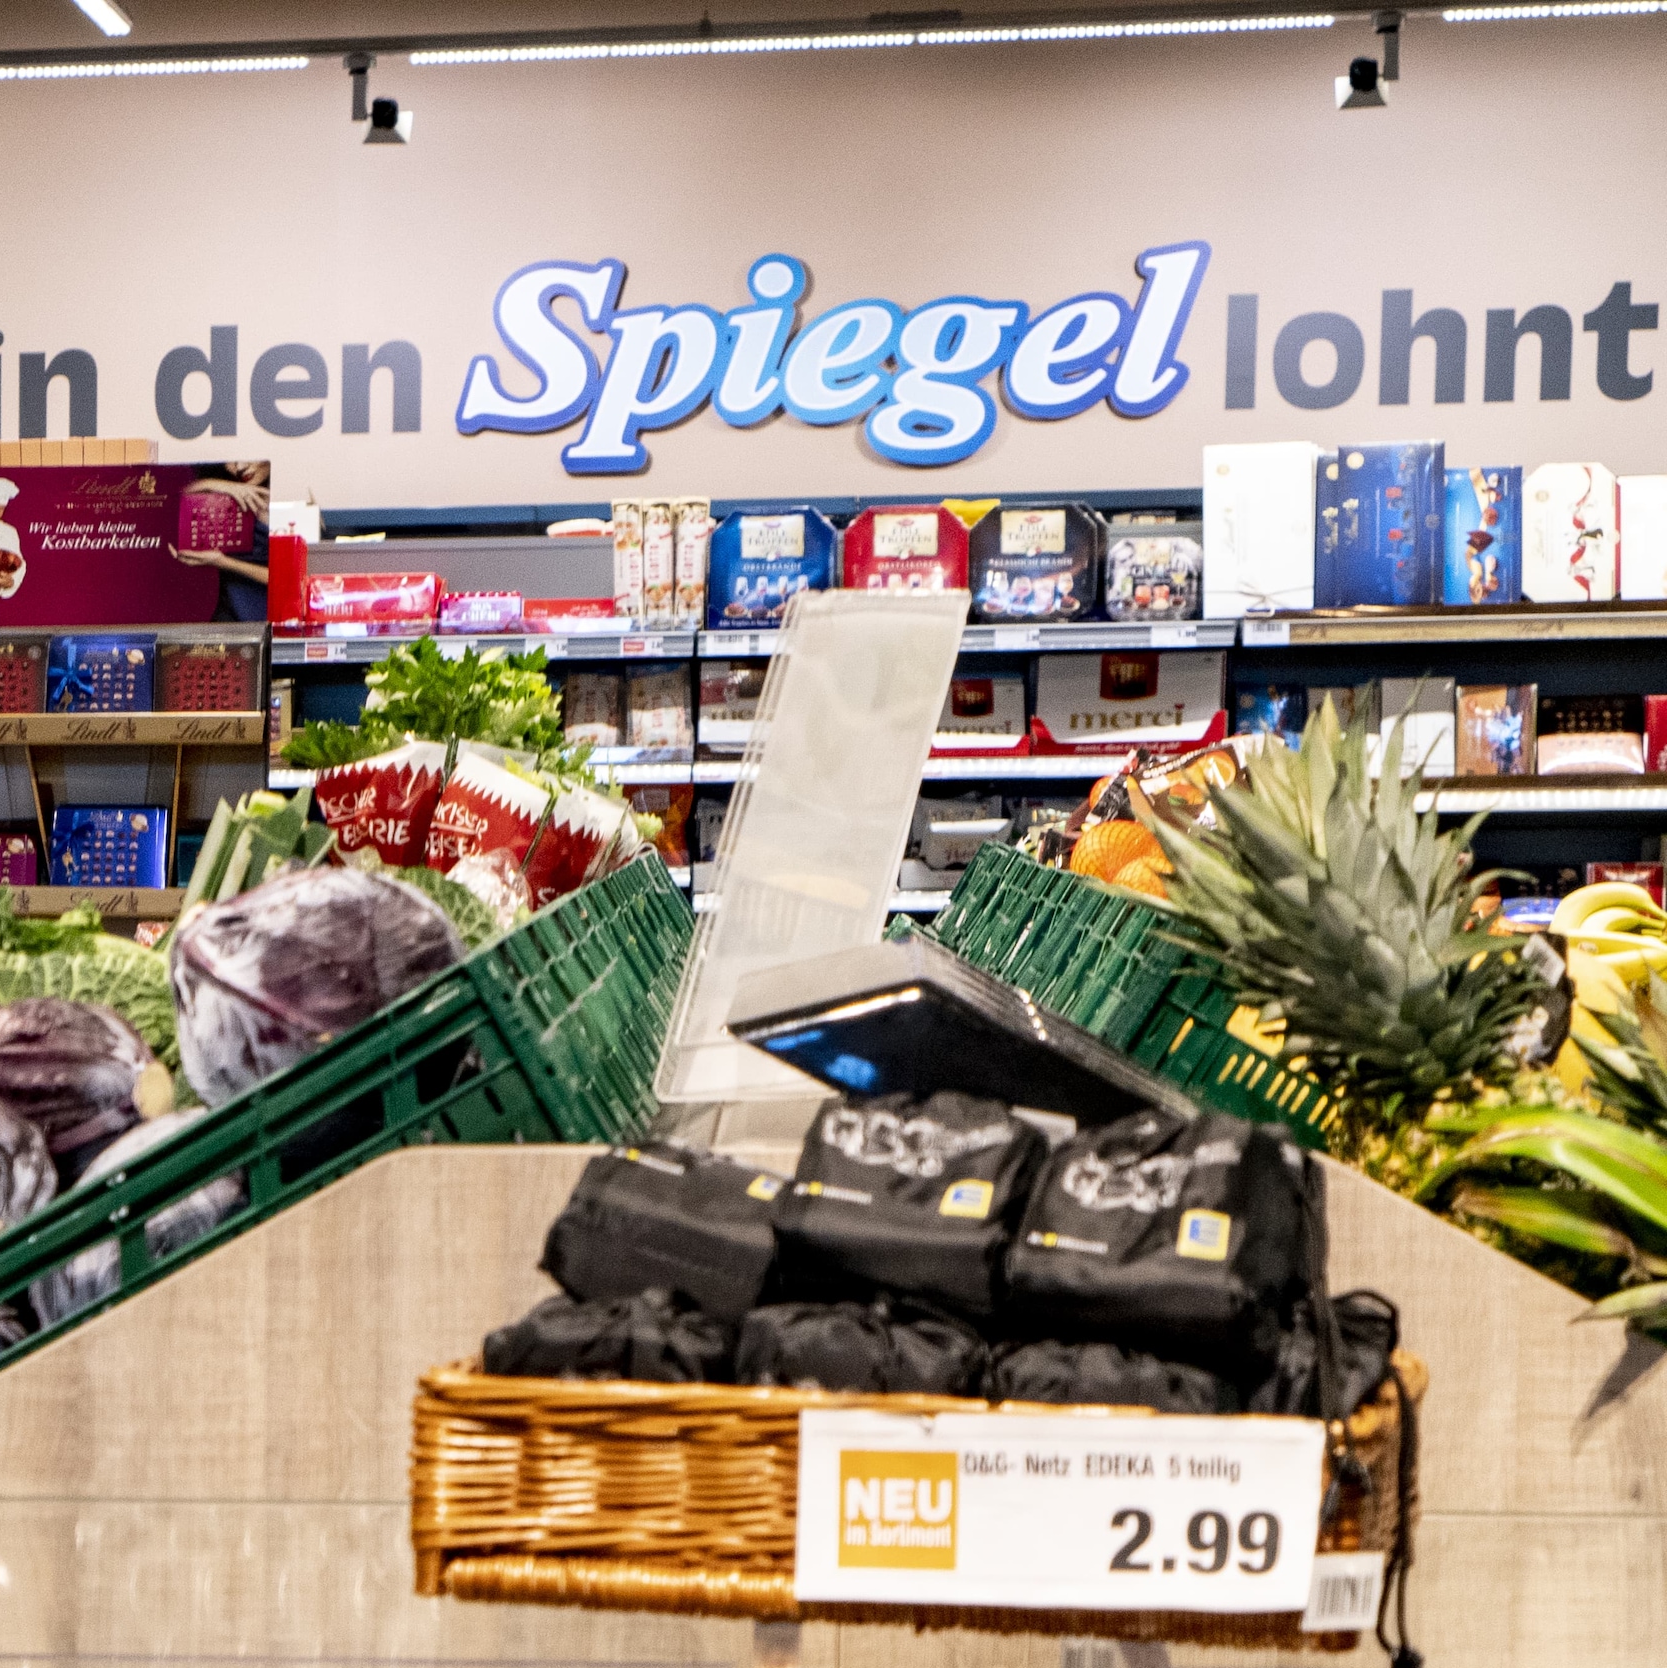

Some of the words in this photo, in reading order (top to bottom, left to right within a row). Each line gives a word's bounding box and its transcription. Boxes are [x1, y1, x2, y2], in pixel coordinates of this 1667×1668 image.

[153, 324, 422, 442] den
[456, 239, 1212, 476] Spiegel
[1225, 281, 1659, 411] lohnt
[29, 522, 52, 534] Wir
[55, 521, 93, 534] lieben
[98, 521, 136, 534] kleine
[41, 534, 161, 550] Kostbarkeiten
[67, 719, 122, 741] Lindt
[174, 719, 231, 741] Lindt
[1069, 704, 1185, 731] merci
[1025, 1453, 1070, 1478] Netz
[1085, 1454, 1155, 1479] EDEKA
[1169, 1456, 1180, 1479] 5
[1190, 1453, 1242, 1484] teilig
[844, 1477, 953, 1522] NEU
[845, 1524, 867, 1546] im
[869, 1522, 952, 1549] Sortiment
[1109, 1507, 1283, 1575] 2.99
